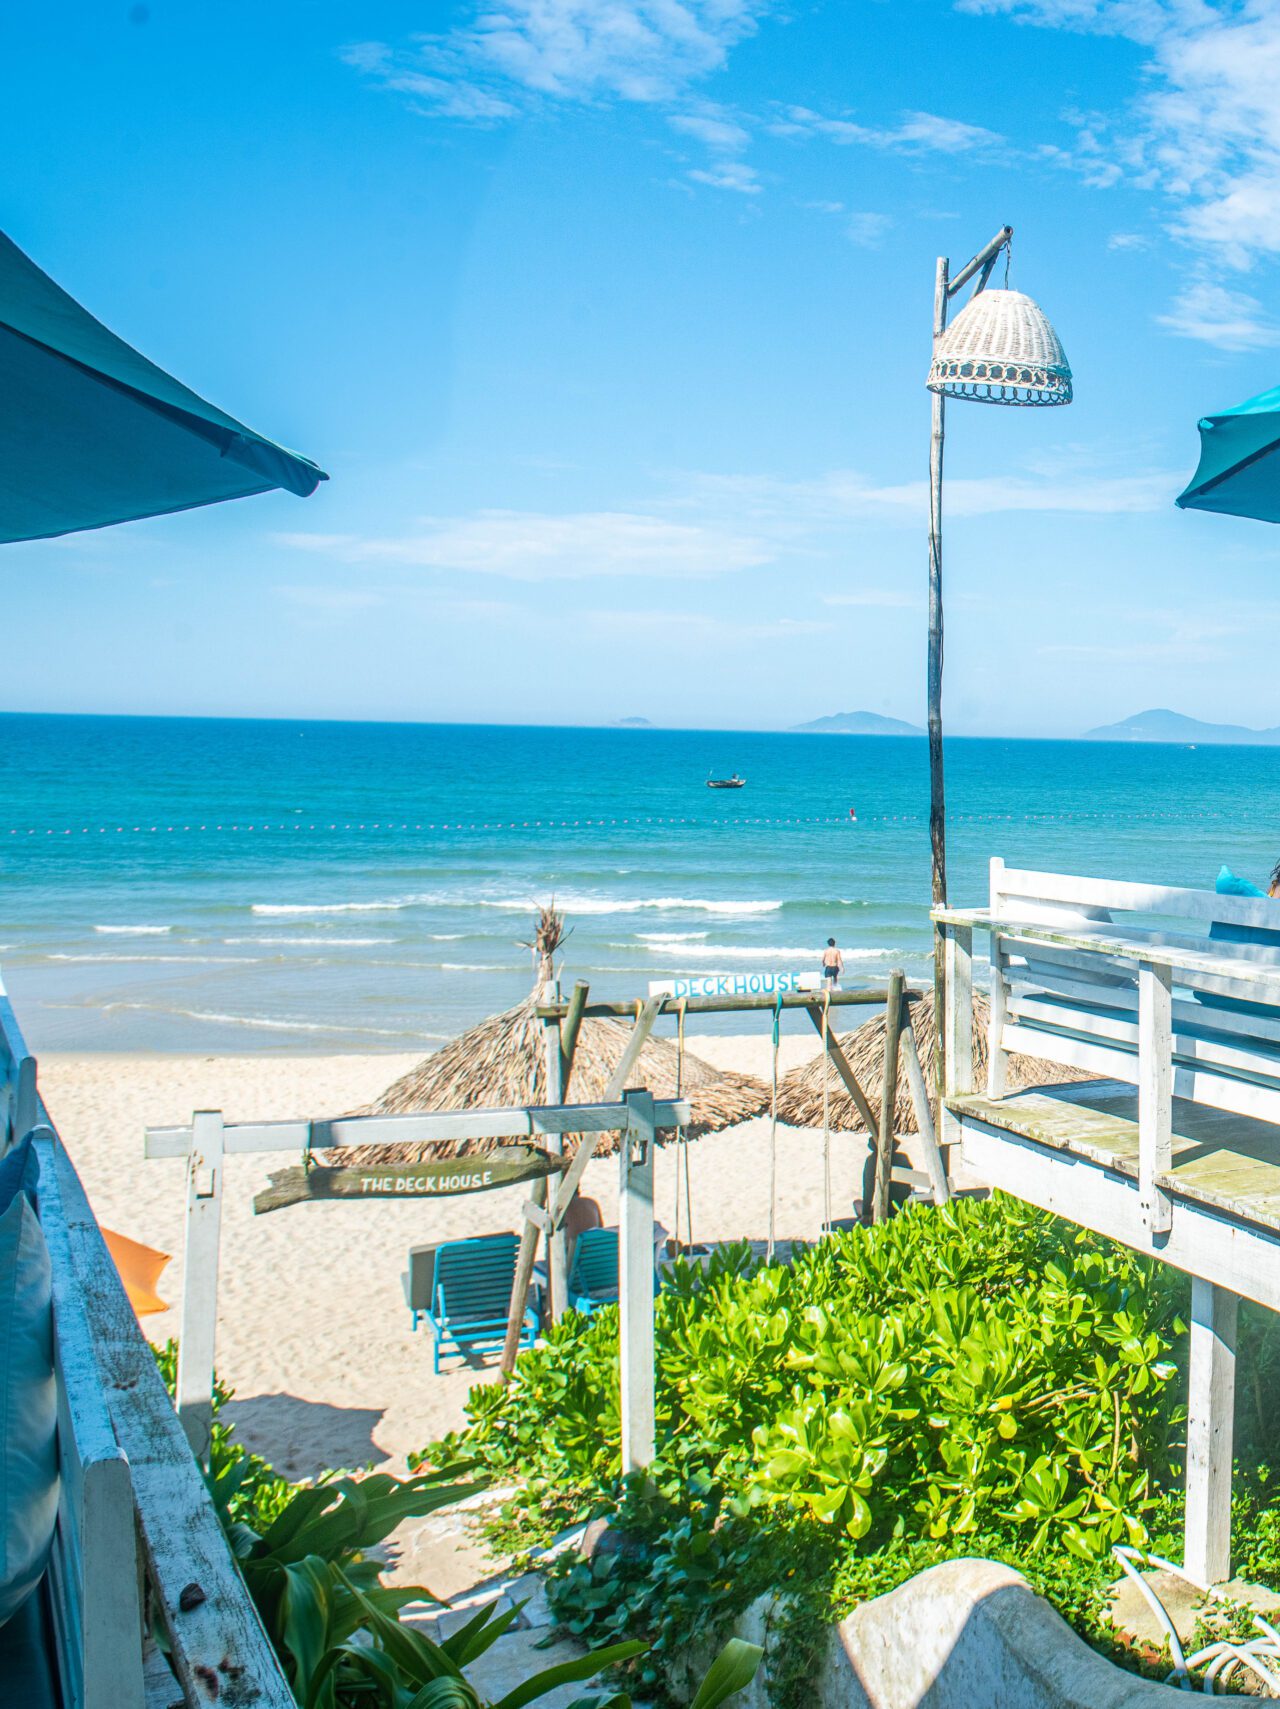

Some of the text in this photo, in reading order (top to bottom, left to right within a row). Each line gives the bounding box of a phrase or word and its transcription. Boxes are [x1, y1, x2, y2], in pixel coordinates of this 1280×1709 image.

[360, 1171, 493, 1193] THE DECK HOUSE
